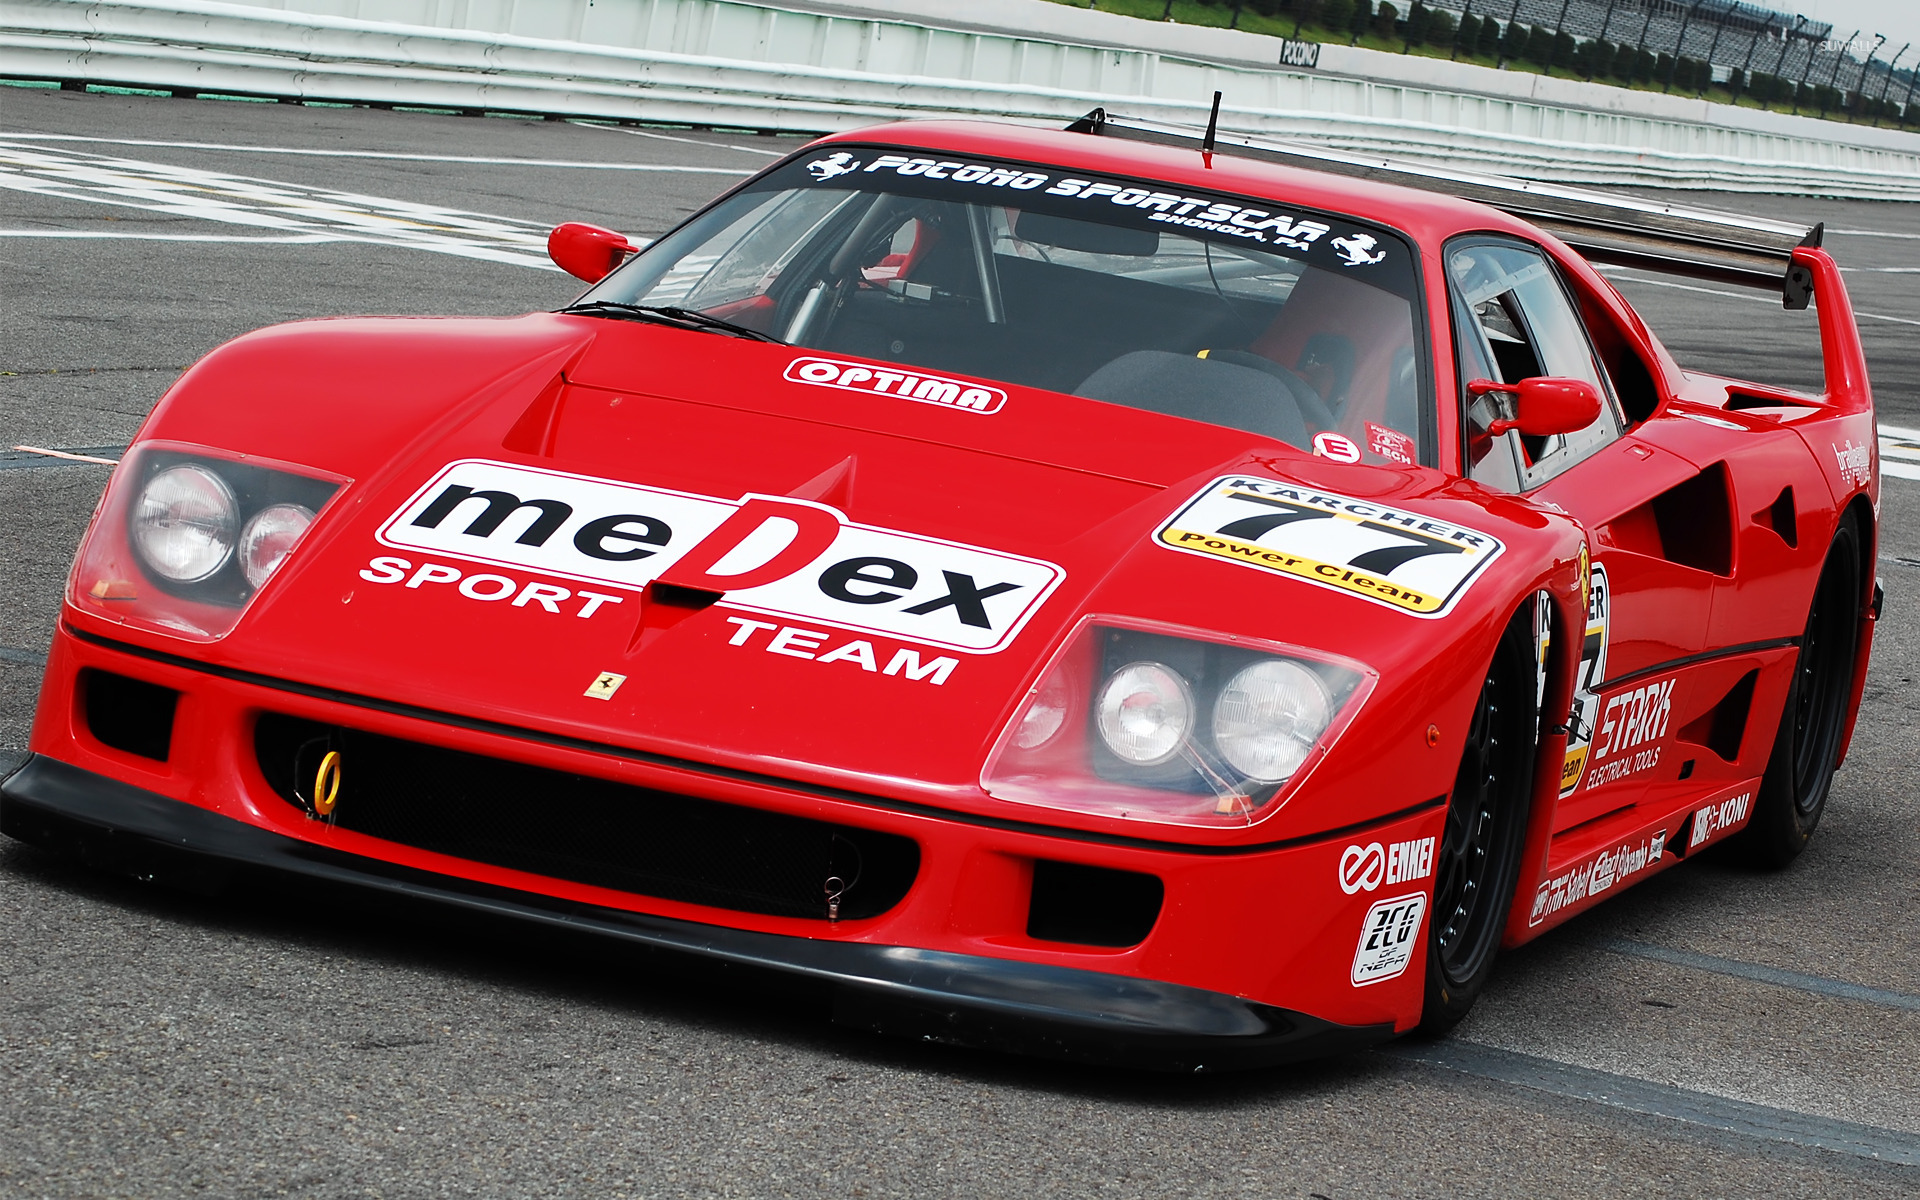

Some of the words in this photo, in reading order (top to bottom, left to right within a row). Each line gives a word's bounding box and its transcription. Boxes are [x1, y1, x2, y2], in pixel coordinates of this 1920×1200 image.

[1282, 40, 1317, 66] POCONO
[864, 155, 1049, 190] POCONO
[1045, 178, 1330, 242] SPORTSCAR
[1273, 236, 1311, 252] PA
[799, 363, 992, 411] OPTIMA
[1371, 443, 1411, 465] TECH
[1215, 491, 1467, 577] 77
[1179, 532, 1303, 567] Power
[1314, 564, 1424, 606] Clean
[359, 556, 624, 620] SPORT
[726, 617, 961, 686] TEAM
[1595, 678, 1676, 760] STARK
[1586, 756, 1633, 791] ELECTRICAL
[1632, 746, 1661, 773] TOOLS
[1716, 792, 1750, 831] KONI
[1386, 837, 1435, 885] ENKEI
